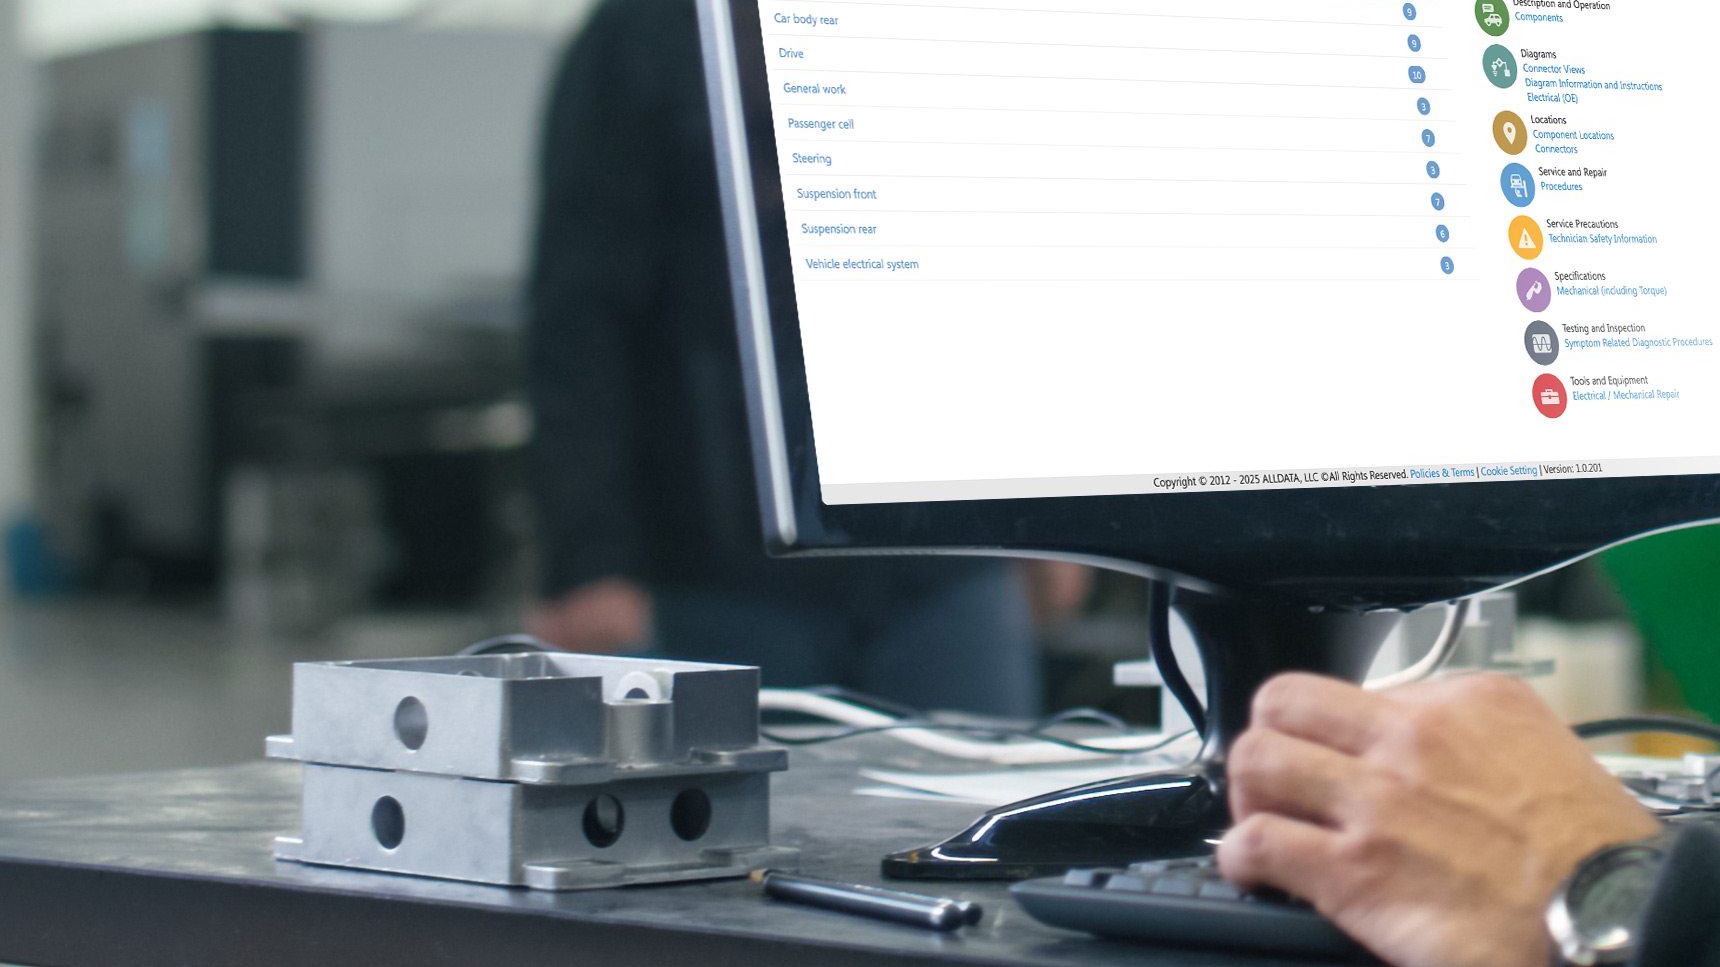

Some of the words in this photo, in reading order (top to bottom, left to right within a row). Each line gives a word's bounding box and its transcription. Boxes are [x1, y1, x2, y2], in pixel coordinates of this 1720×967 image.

[1557, 0, 1572, 8] and
[1573, 0, 1611, 10] Operation
[774, 12, 790, 23] Car
[793, 13, 817, 27] body
[820, 16, 839, 25] rear
[1515, 12, 1563, 23] Components
[778, 47, 804, 59] Drive
[1520, 49, 1557, 60] Diagrams
[1522, 63, 1562, 74] Connector
[1563, 64, 1586, 75] Views
[783, 82, 820, 94] General
[822, 84, 847, 94] work
[1524, 78, 1558, 90] Diagram
[1558, 78, 1603, 90] Information
[1604, 80, 1618, 90] and
[1620, 80, 1663, 91] Instructions
[1526, 92, 1561, 103] Electrical
[1562, 93, 1578, 105] (OE)
[787, 117, 836, 132] Passenger
[838, 118, 854, 129] cell
[1530, 115, 1567, 125] Locations
[1532, 129, 1577, 141] Component
[1579, 131, 1614, 141] Locations
[1535, 144, 1578, 154] Connectors
[792, 152, 832, 166] Steering
[1538, 167, 1566, 177] Service
[1567, 167, 1581, 177] and
[1583, 167, 1607, 179] Repair
[1540, 181, 1582, 191] Procedures
[796, 188, 851, 201] Suspension
[853, 188, 877, 199] front
[801, 223, 856, 236] Suspension
[858, 225, 877, 234] rear
[1546, 219, 1574, 229] Service
[1575, 219, 1619, 229] Precautions
[1548, 233, 1588, 244] Technician
[1589, 234, 1613, 246] Safety
[1614, 234, 1657, 244] Information
[805, 258, 840, 269] Vehicle
[842, 258, 884, 269] electrical
[887, 260, 919, 272] system
[1554, 271, 1606, 282] Specifications
[1556, 285, 1599, 296] Mechanical
[1601, 285, 1638, 297] (including
[1639, 285, 1667, 297] Torque)
[1562, 323, 1589, 335] Testing
[1591, 324, 1605, 333] and
[1606, 323, 1646, 334] Inspection
[1564, 338, 1601, 350] Symptom
[1602, 338, 1630, 347] Related
[1632, 337, 1671, 349] Diagnostic
[1672, 337, 1713, 346] Procedures
[1570, 376, 1590, 386] Tools
[1591, 376, 1606, 385] and
[1608, 376, 1648, 387] Equipment
[1572, 391, 1606, 400] Electrical
[1613, 389, 1655, 400] Mechanical
[1656, 389, 1680, 401] Repair
[1153, 476, 1197, 489] Copyright
[1209, 475, 1230, 486] 2012
[1239, 474, 1260, 485] 2025
[1262, 473, 1302, 484] ALLDATA,
[1304, 472, 1318, 482] LLC
[1342, 471, 1368, 483] Rights
[1369, 469, 1409, 480] Reserved.
[1410, 468, 1440, 479] Policies
[1441, 468, 1450, 478] &
[1451, 468, 1474, 478] Terms
[1480, 466, 1508, 477] Cookie
[1510, 465, 1538, 477] Setting
[1543, 464, 1574, 474] Version:
[1576, 463, 1603, 473] 1.0.201
